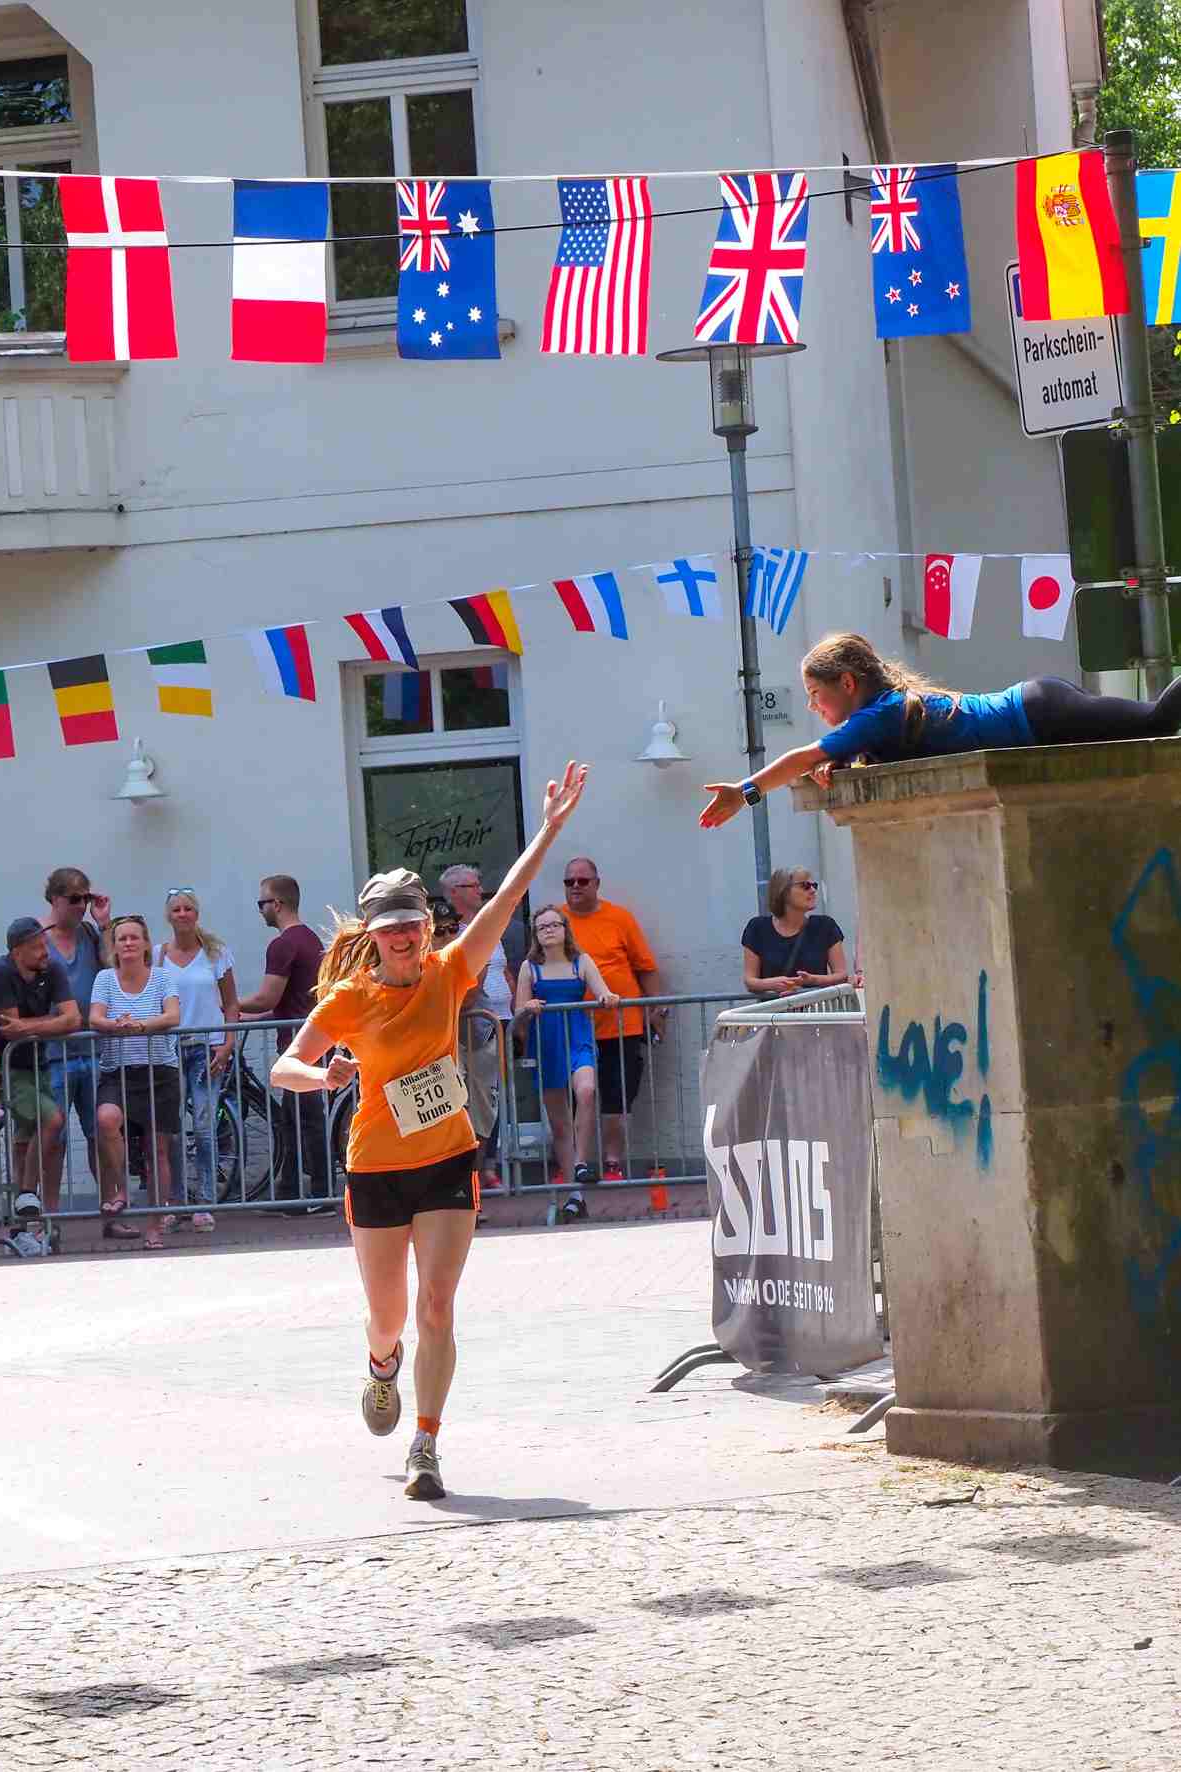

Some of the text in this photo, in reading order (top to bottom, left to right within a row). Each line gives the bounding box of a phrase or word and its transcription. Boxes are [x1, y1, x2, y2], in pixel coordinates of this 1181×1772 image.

[1023, 325, 1105, 364] Parkschein-
[1042, 370, 1099, 405] automat
[400, 1071, 429, 1088] Allianz
[414, 1084, 444, 1107] 510
[416, 1101, 452, 1124] bruns
[793, 1281, 812, 1311] SEIT
[814, 1284, 834, 1313] 1896
